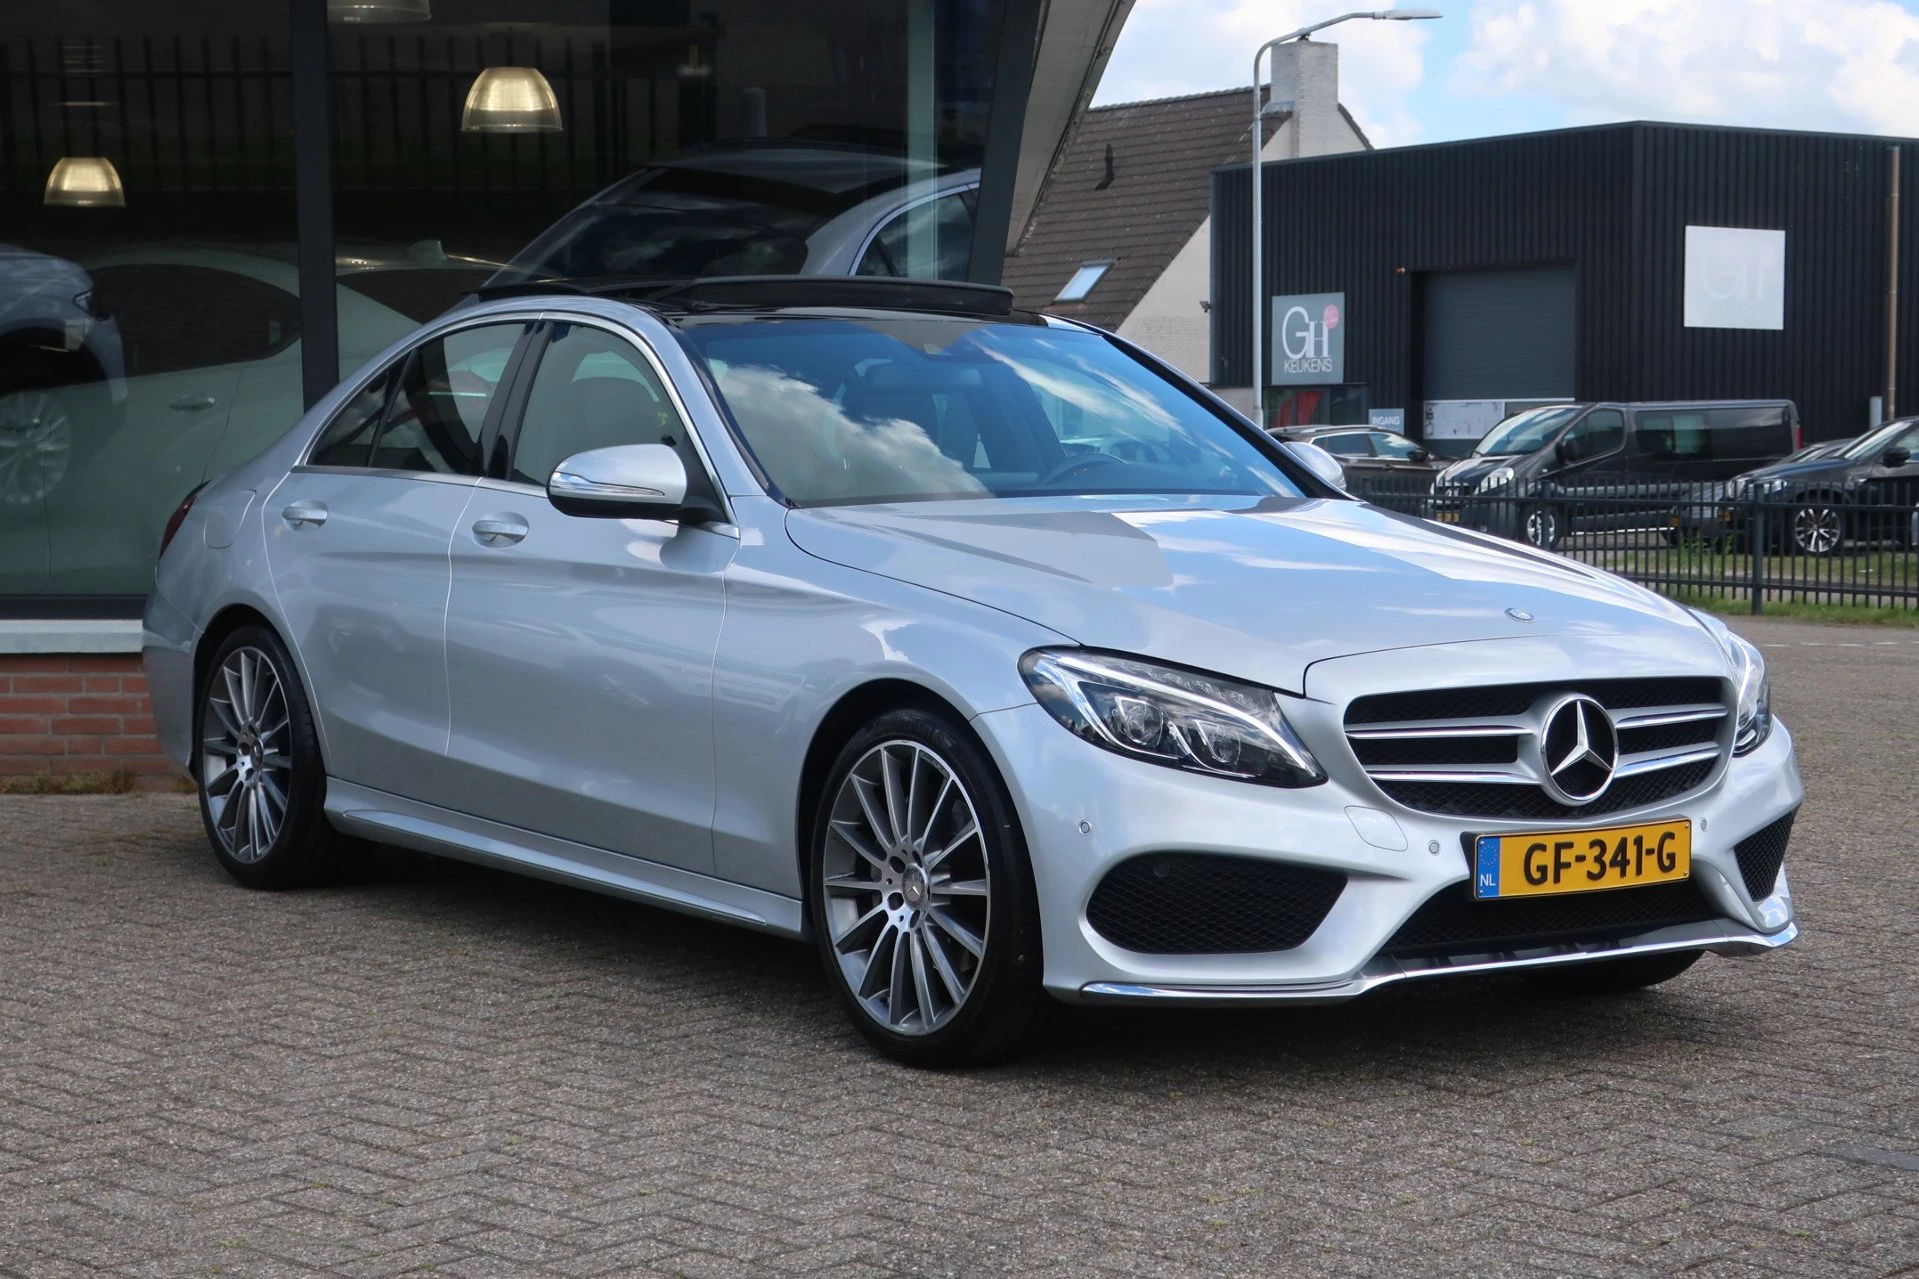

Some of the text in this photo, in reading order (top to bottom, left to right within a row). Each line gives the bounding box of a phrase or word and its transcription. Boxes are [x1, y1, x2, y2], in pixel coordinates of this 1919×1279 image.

[1283, 358, 1333, 374] KEUKENS
[1523, 831, 1676, 886] GF-341-G
[1480, 874, 1496, 887] NL
